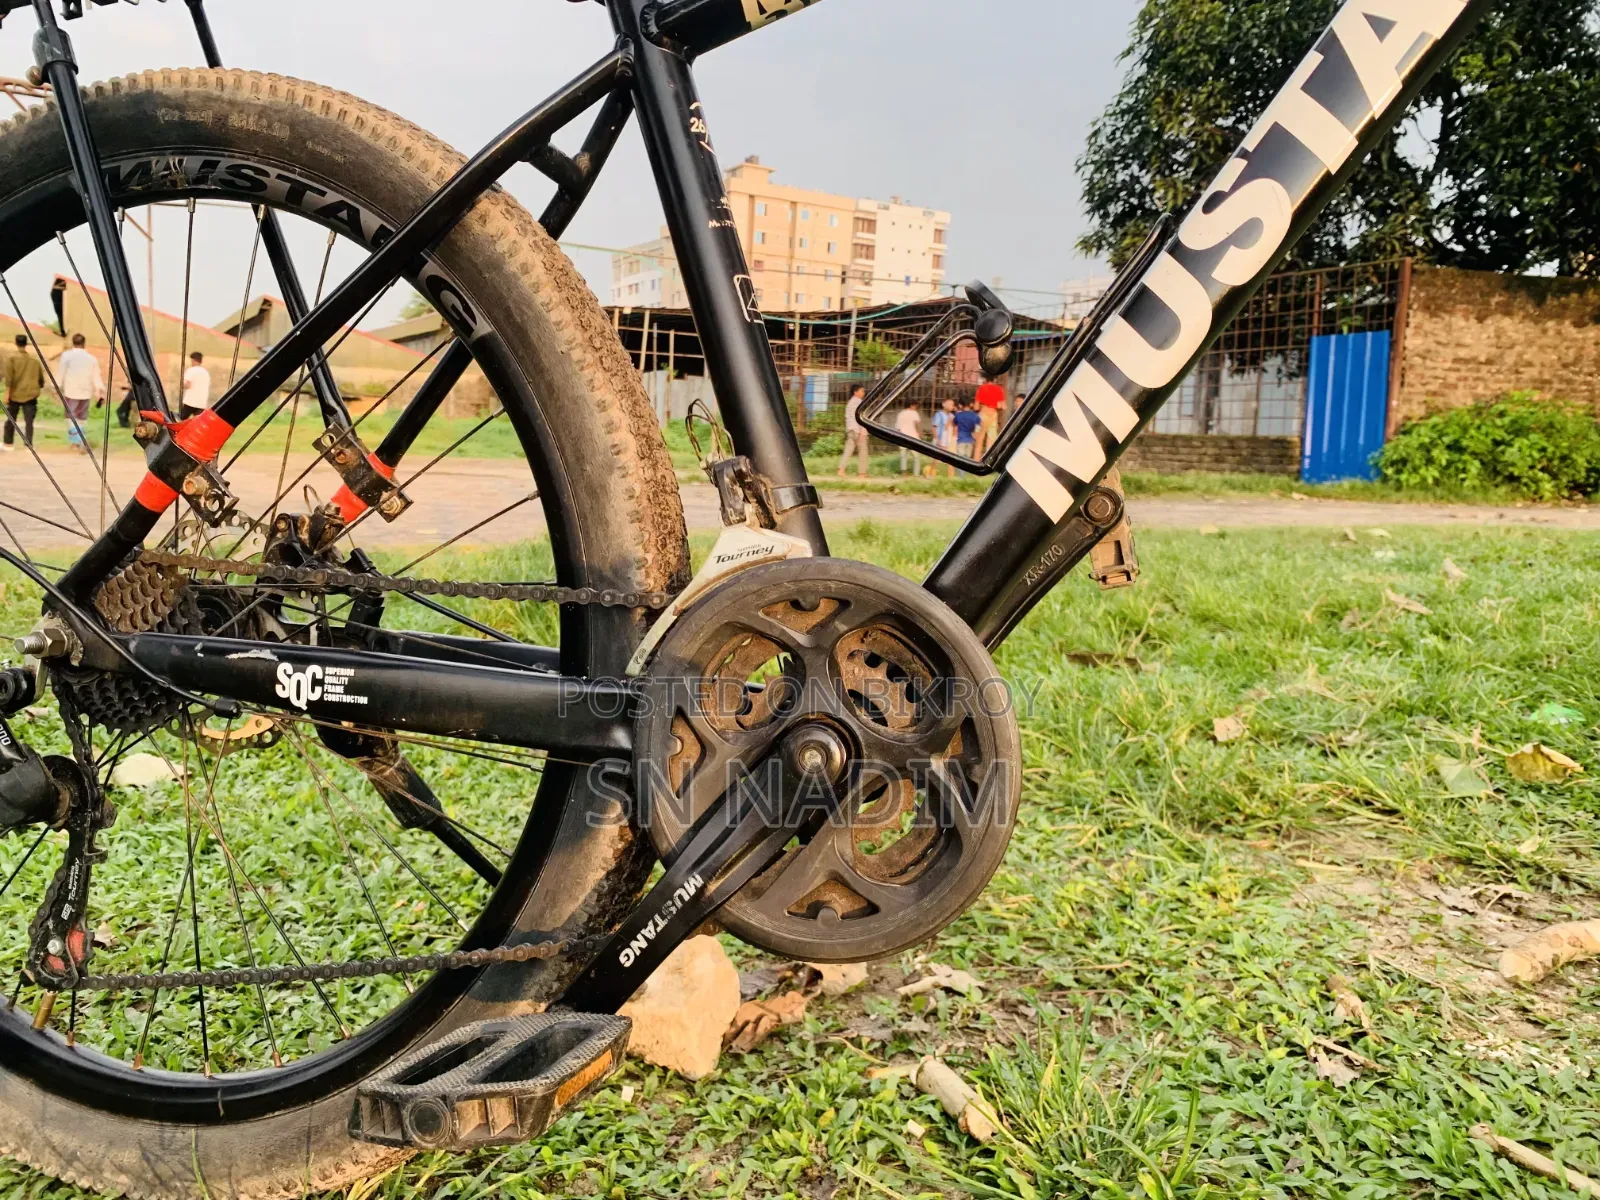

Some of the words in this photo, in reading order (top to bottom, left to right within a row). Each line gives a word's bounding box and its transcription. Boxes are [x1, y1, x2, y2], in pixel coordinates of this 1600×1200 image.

[690, 117, 706, 133] 26
[713, 545, 776, 564] Tourney
[325, 666, 355, 677] SUPERIOR
[275, 662, 323, 711] SQC
[324, 675, 349, 685] QUALITY
[324, 684, 345, 694] FRAME
[323, 693, 368, 704] CONSTRUCTION
[619, 872, 704, 967] MUSTANG
